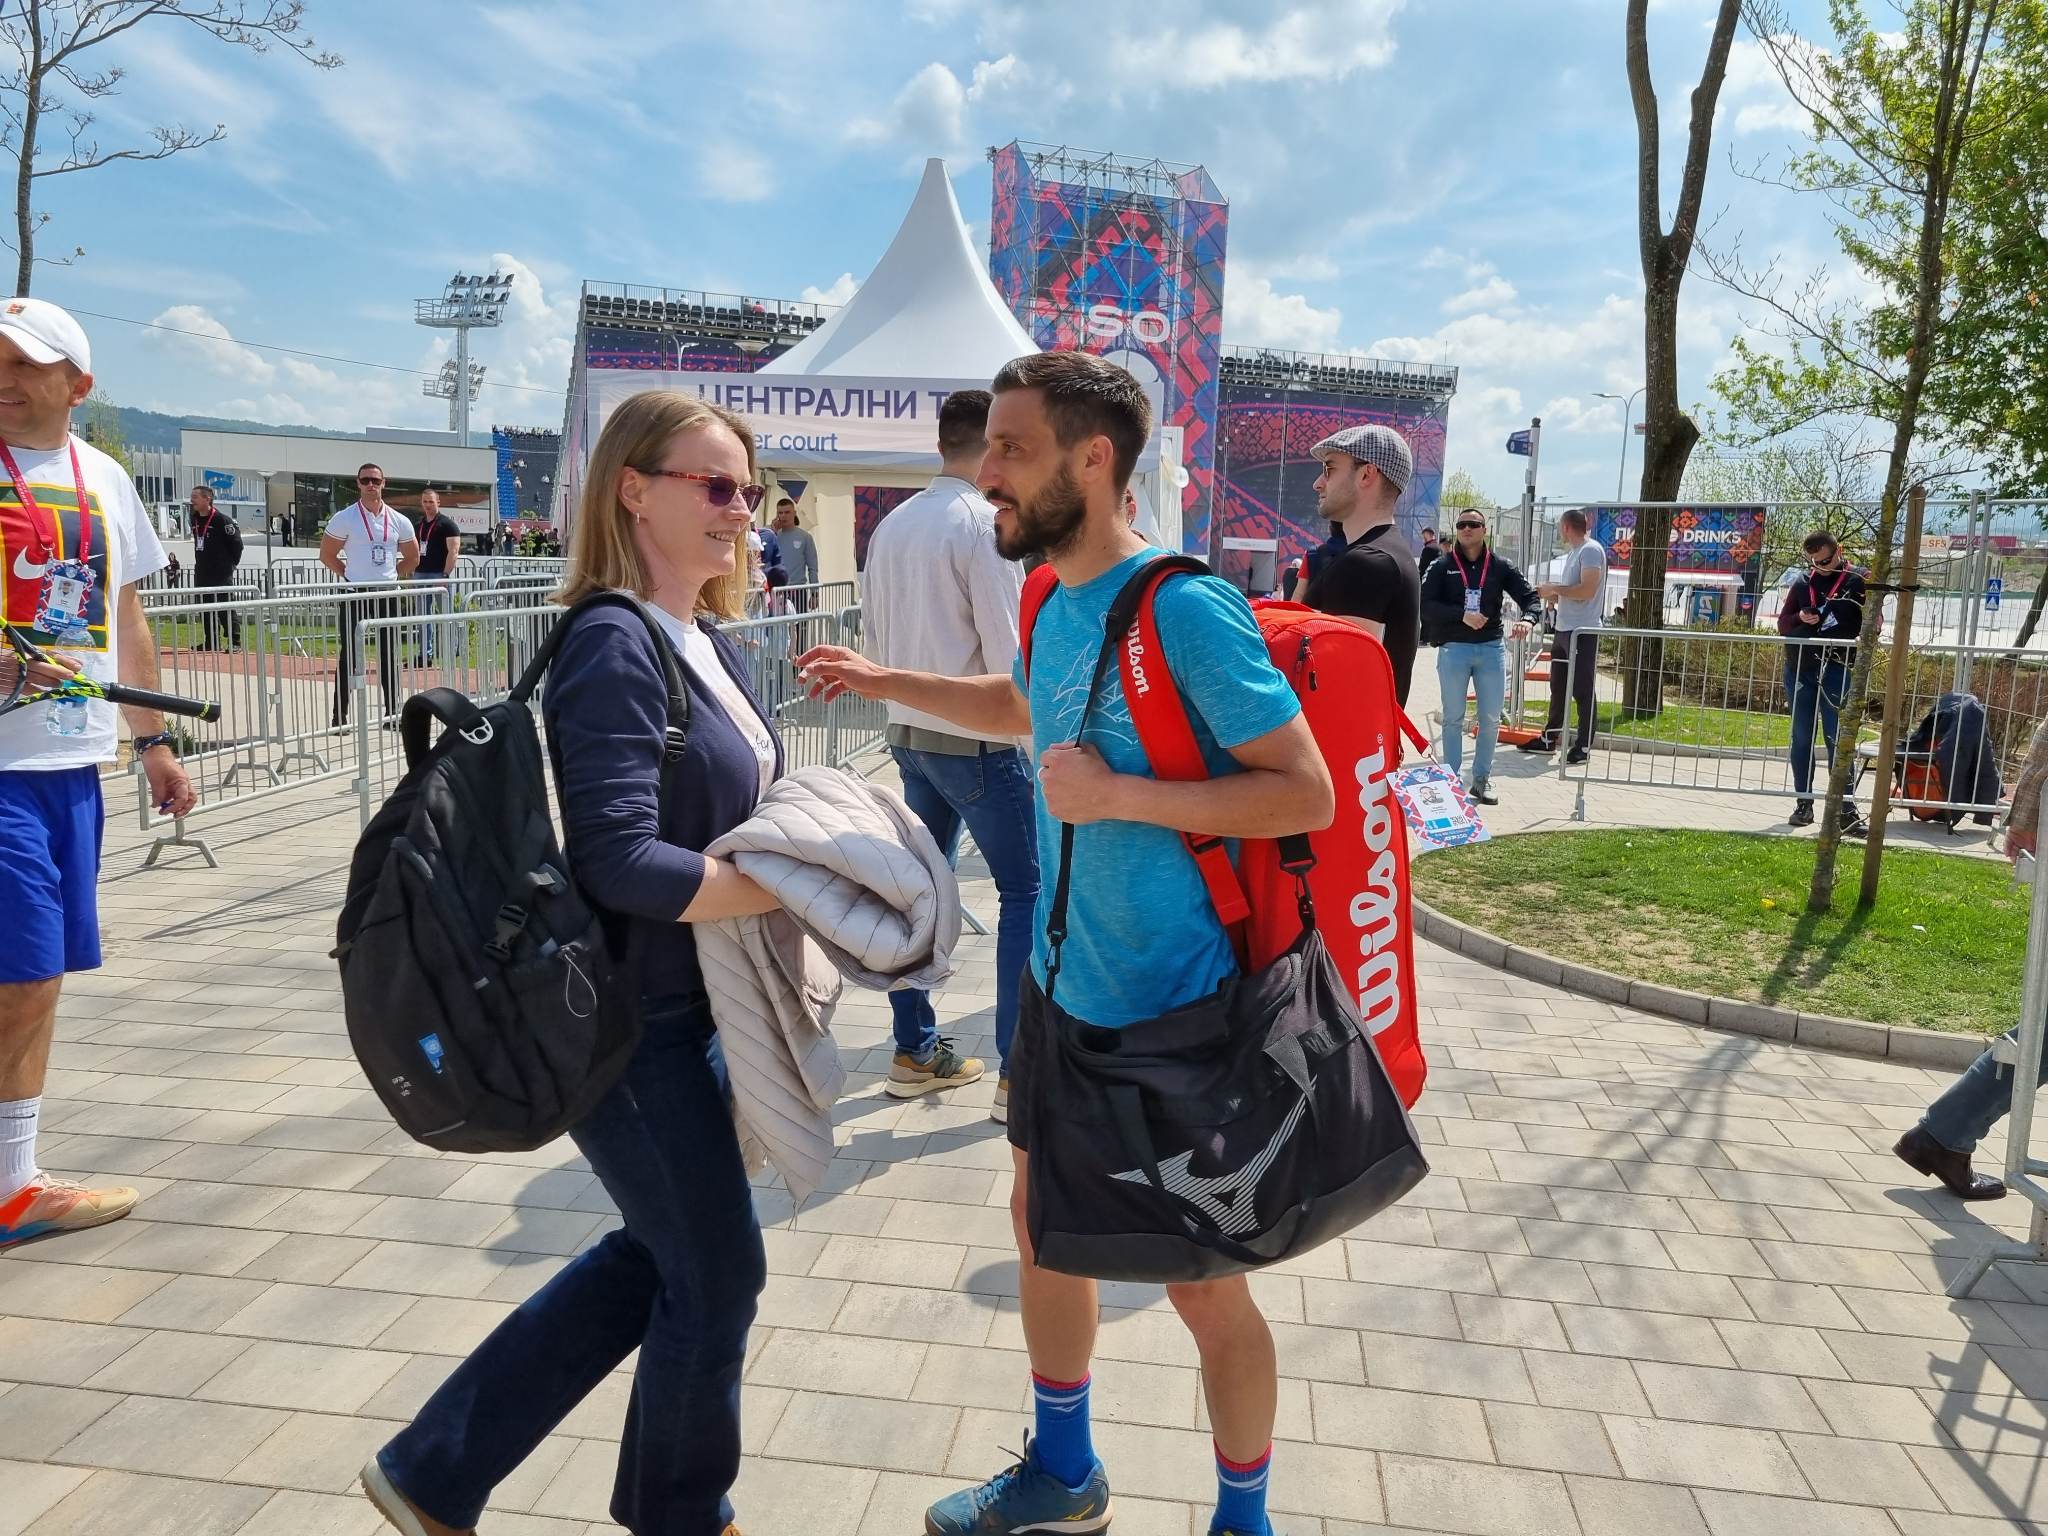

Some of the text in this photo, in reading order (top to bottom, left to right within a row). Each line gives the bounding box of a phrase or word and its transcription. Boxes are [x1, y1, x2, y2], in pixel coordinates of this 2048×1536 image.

[1088, 304, 1171, 343] SO
[779, 432, 839, 452] court
[1683, 530, 1742, 544] DRINKS
[1350, 745, 1400, 1037] Wilson
